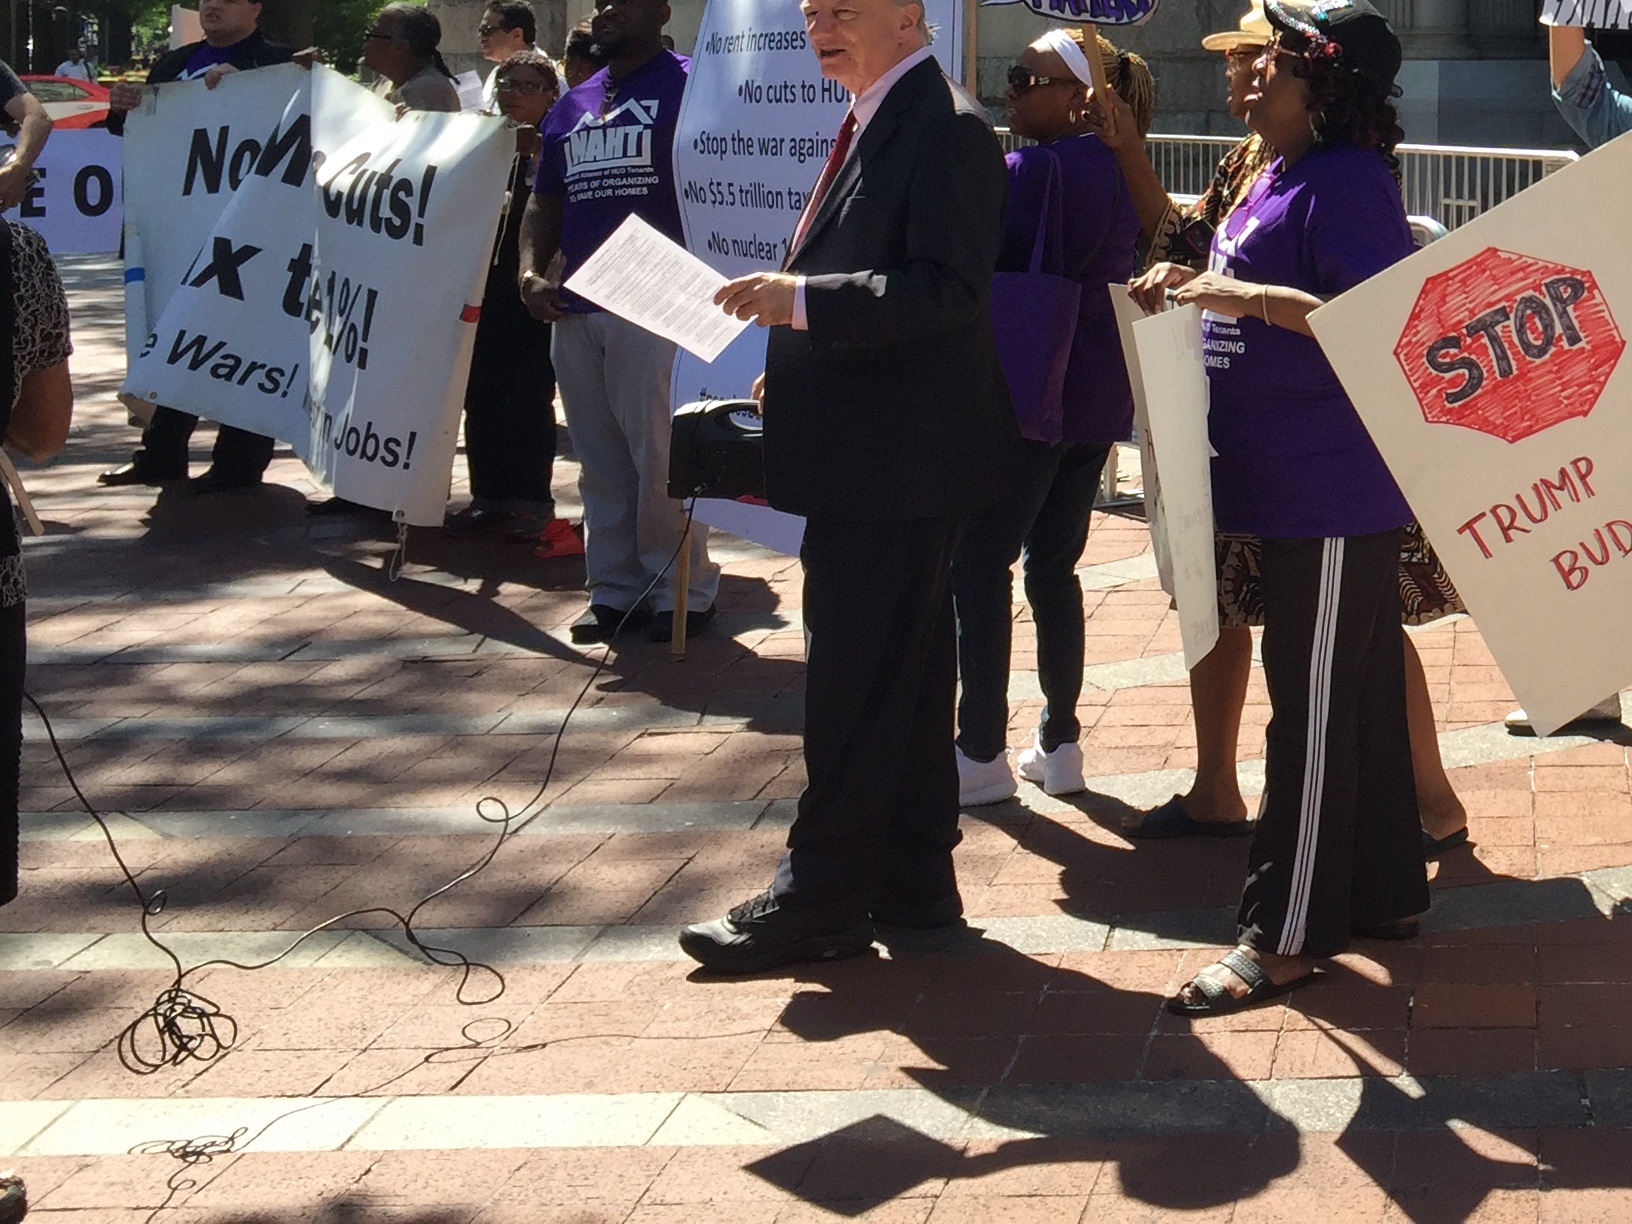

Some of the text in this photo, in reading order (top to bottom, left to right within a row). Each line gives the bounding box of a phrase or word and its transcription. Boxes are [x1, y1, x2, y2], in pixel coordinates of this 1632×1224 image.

[709, 27, 806, 55] No rent increases
[743, 80, 762, 103] No
[767, 80, 797, 104] cuts
[801, 80, 816, 104] to
[570, 125, 644, 165] NAHT
[699, 129, 836, 164] Stop the war agains
[590, 180, 601, 188] OF
[602, 176, 659, 187] ORGANIZING
[594, 189, 613, 197] OUR
[615, 187, 648, 196] HOMES
[688, 181, 707, 204] No
[709, 178, 736, 208] $5.5
[739, 182, 784, 209] trillion
[322, 151, 438, 246] Cuts!
[711, 231, 729, 256] No
[732, 233, 778, 261] nuclear
[1203, 338, 1245, 354] GANIZING
[1425, 277, 1586, 404] STOP
[166, 329, 299, 398] Wars!
[1204, 355, 1231, 369] OMES
[334, 413, 417, 470] Jobs!
[1457, 456, 1597, 559] TRUMP
